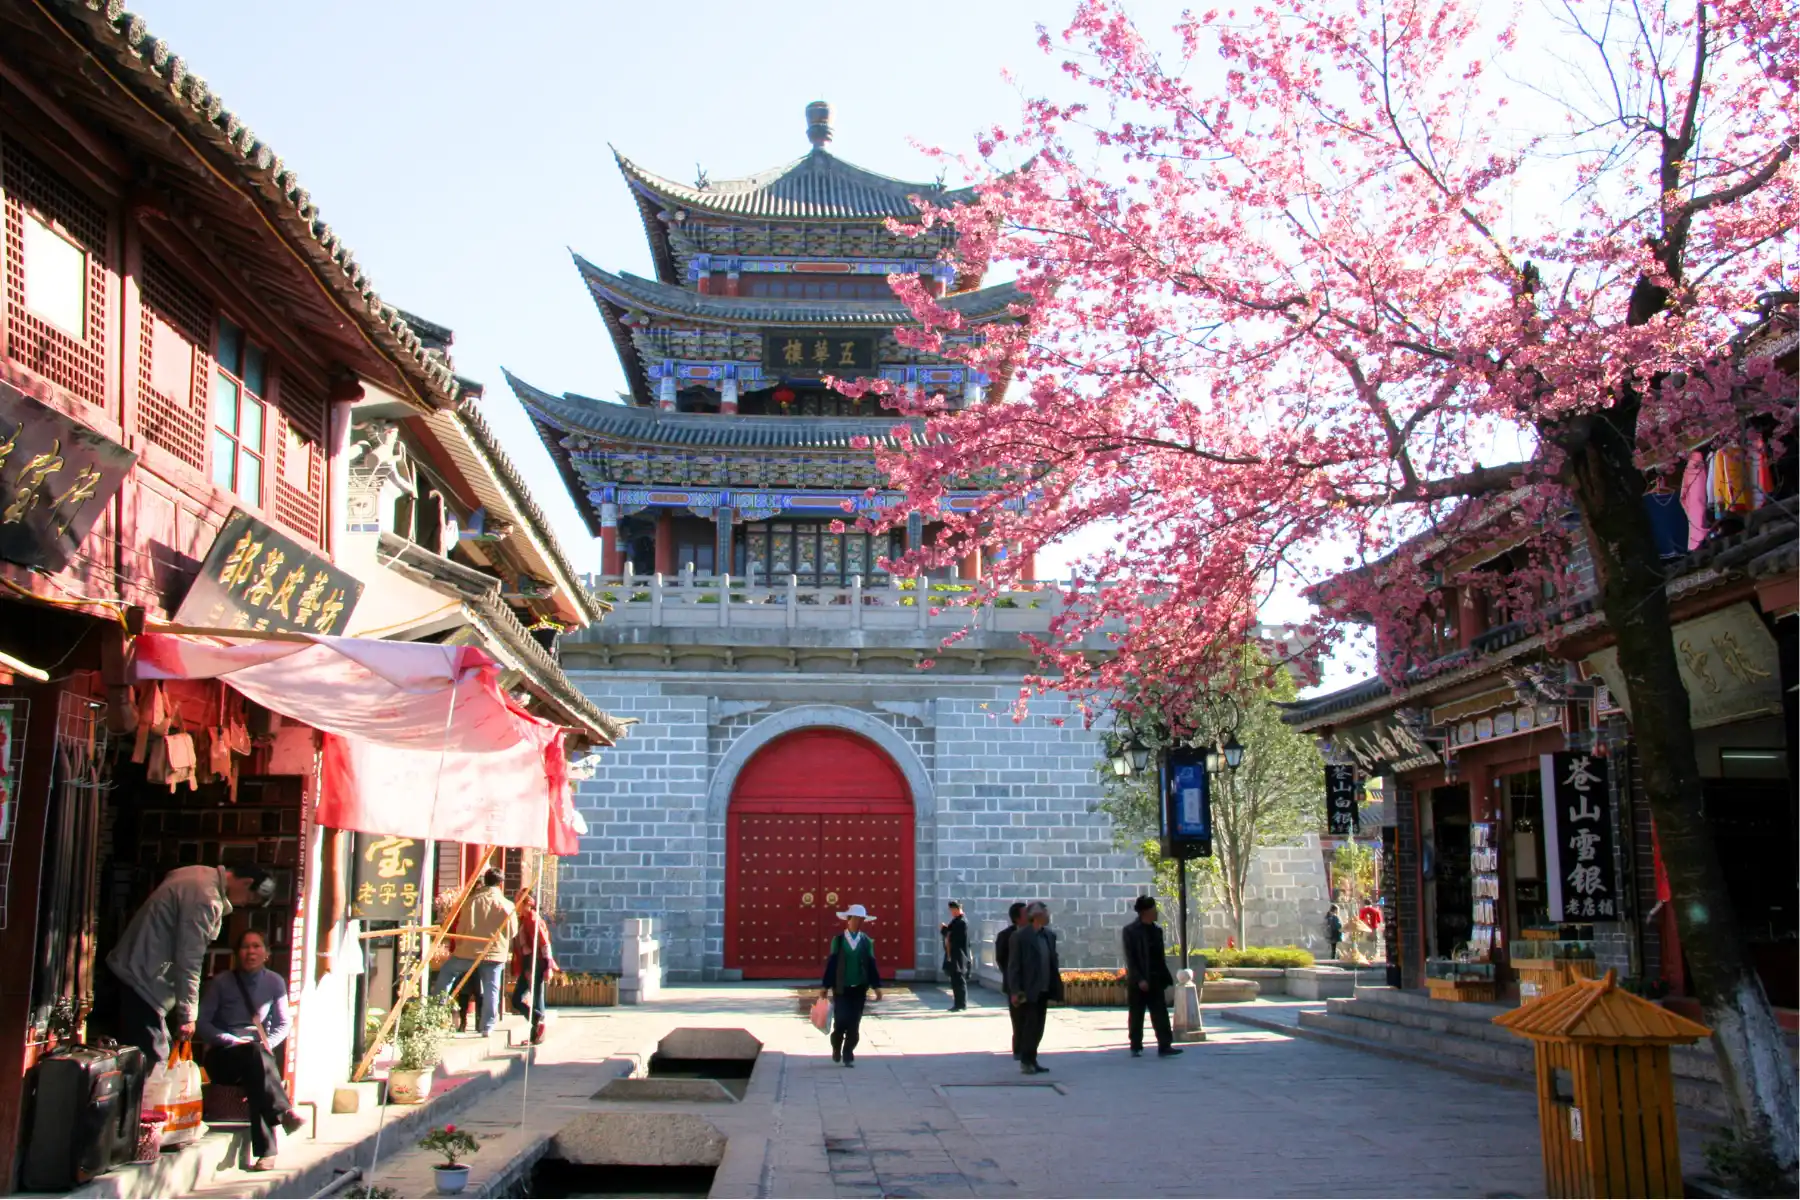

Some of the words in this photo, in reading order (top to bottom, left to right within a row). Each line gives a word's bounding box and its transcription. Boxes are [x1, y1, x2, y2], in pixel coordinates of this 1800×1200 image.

[1562, 755, 1608, 895] 苍山雪银
[365, 834, 414, 878] 宝
[357, 881, 418, 907] 老字号
